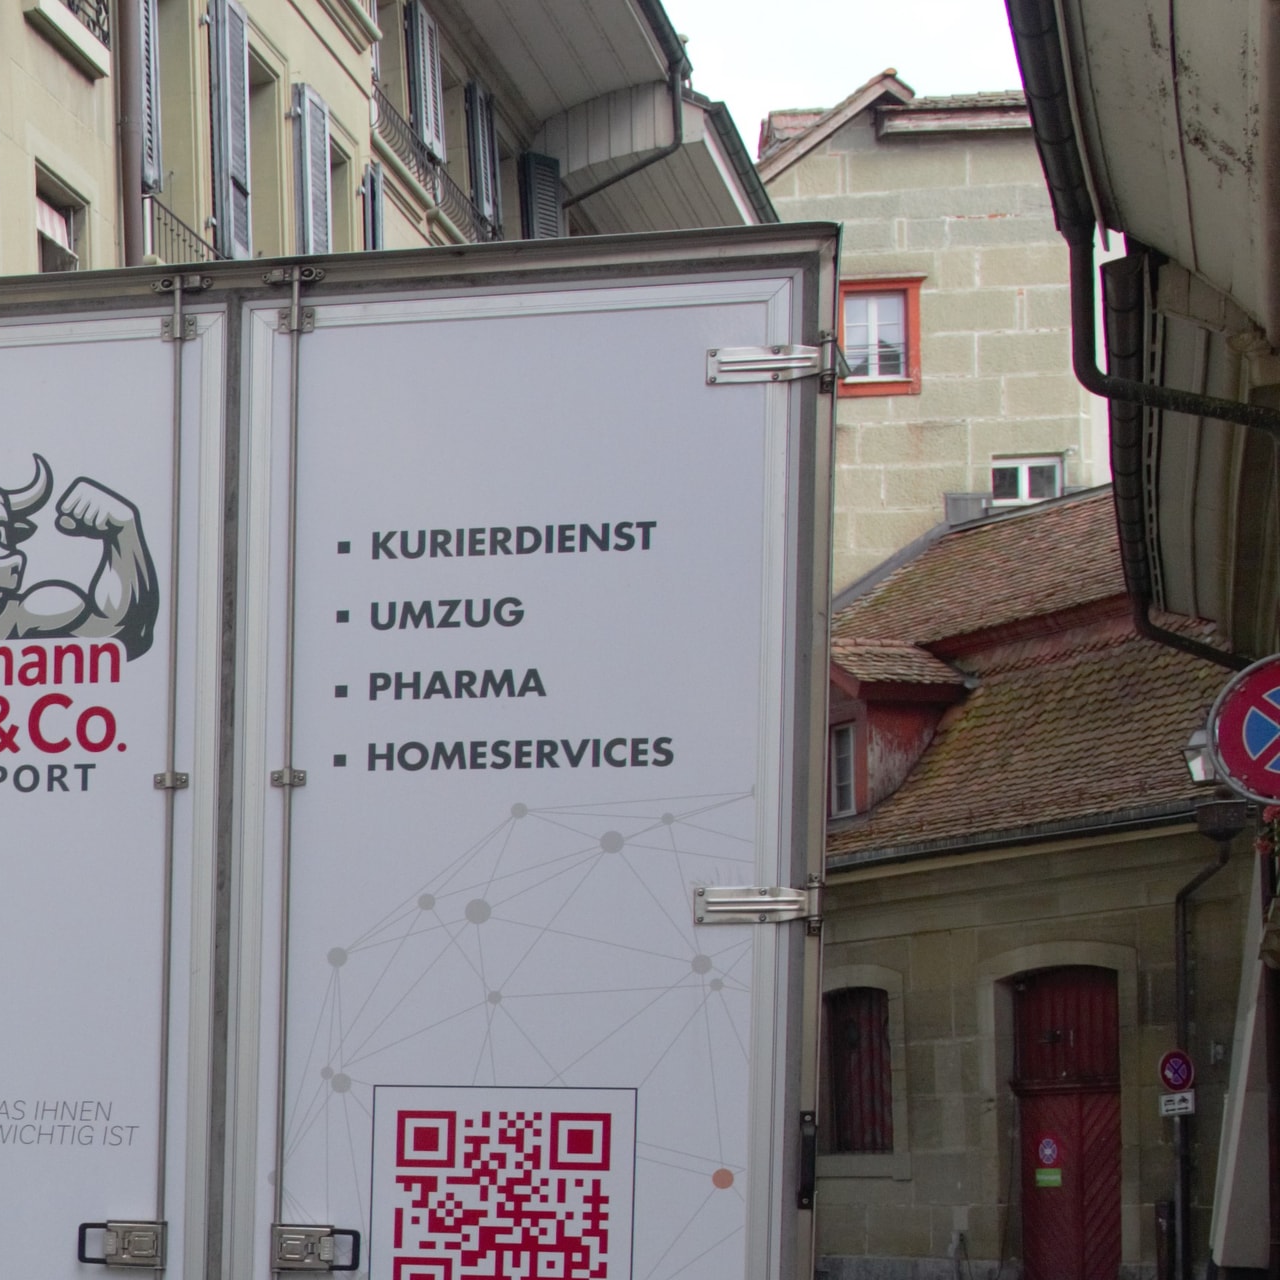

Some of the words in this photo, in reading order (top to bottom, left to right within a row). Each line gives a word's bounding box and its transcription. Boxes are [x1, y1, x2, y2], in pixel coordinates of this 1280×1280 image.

[371, 521, 657, 560] KURIERDIENST
[369, 596, 525, 631] UMZUG
[368, 667, 547, 701] PHARMA
[366, 736, 675, 772] HOMESERVICES
[34, 1100, 113, 1122] IHNEN
[102, 1125, 140, 1147] IST
